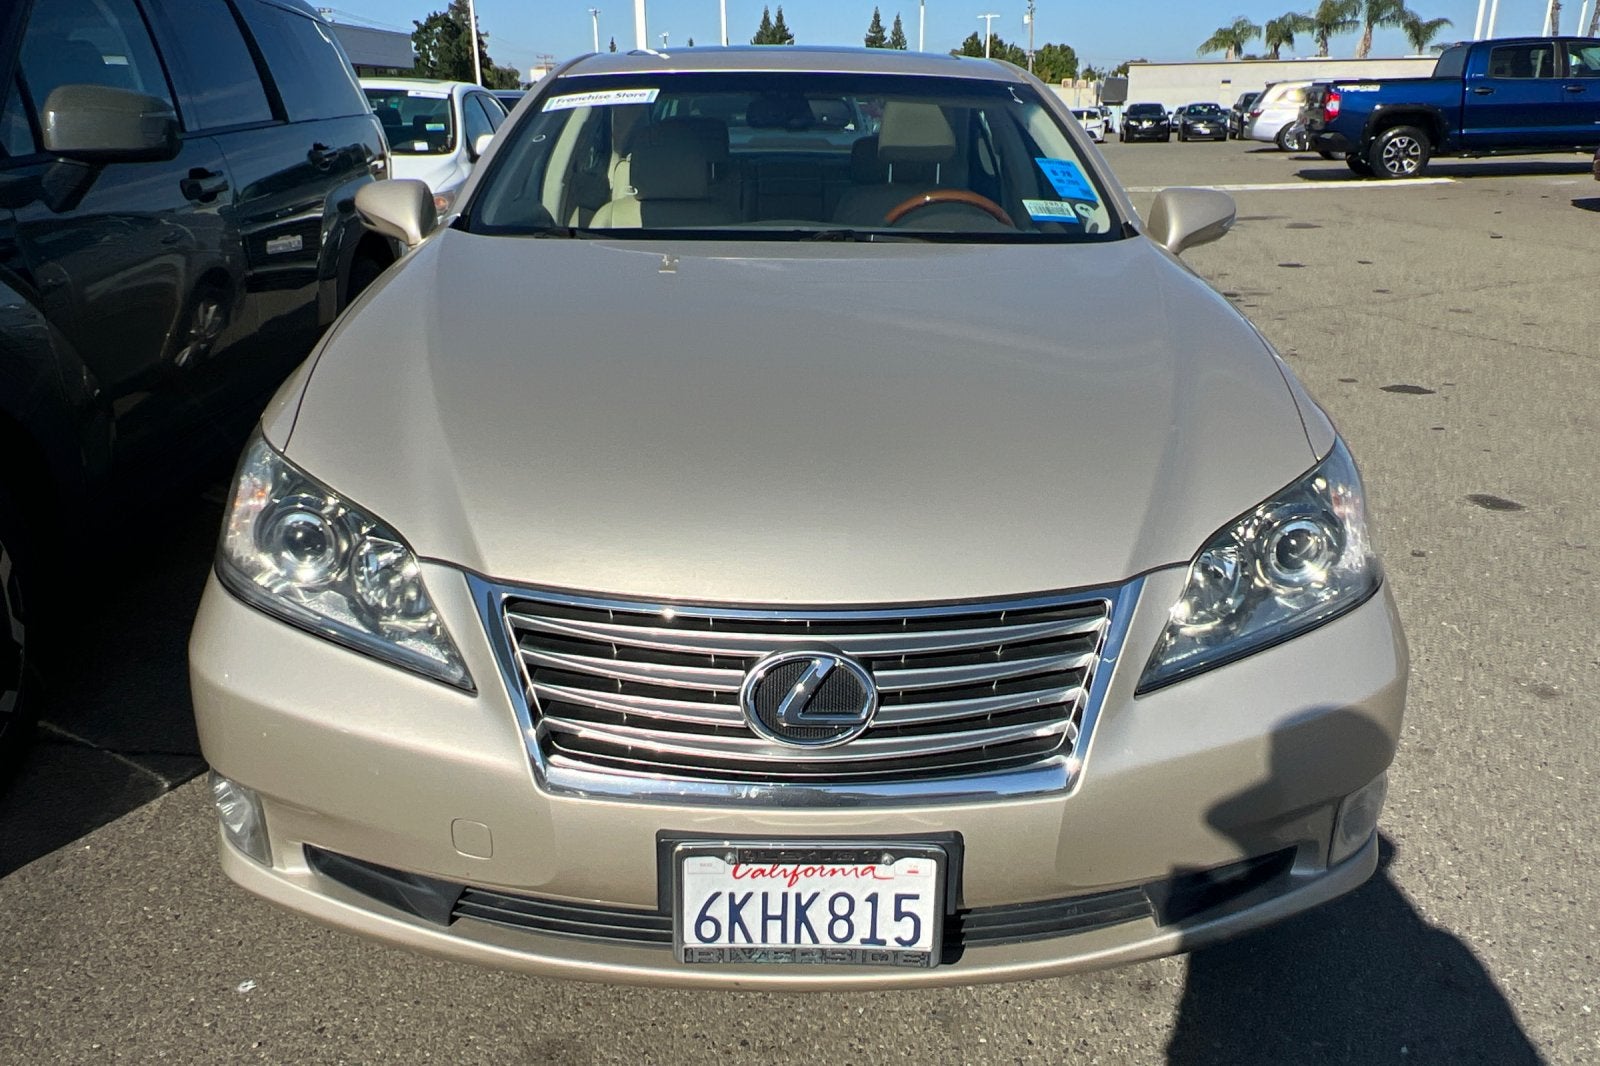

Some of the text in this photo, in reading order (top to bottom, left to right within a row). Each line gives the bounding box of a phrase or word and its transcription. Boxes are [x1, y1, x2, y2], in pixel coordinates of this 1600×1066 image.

[556, 94, 611, 104] Franchise
[732, 863, 895, 888] California
[694, 891, 921, 947] 6KHK815
